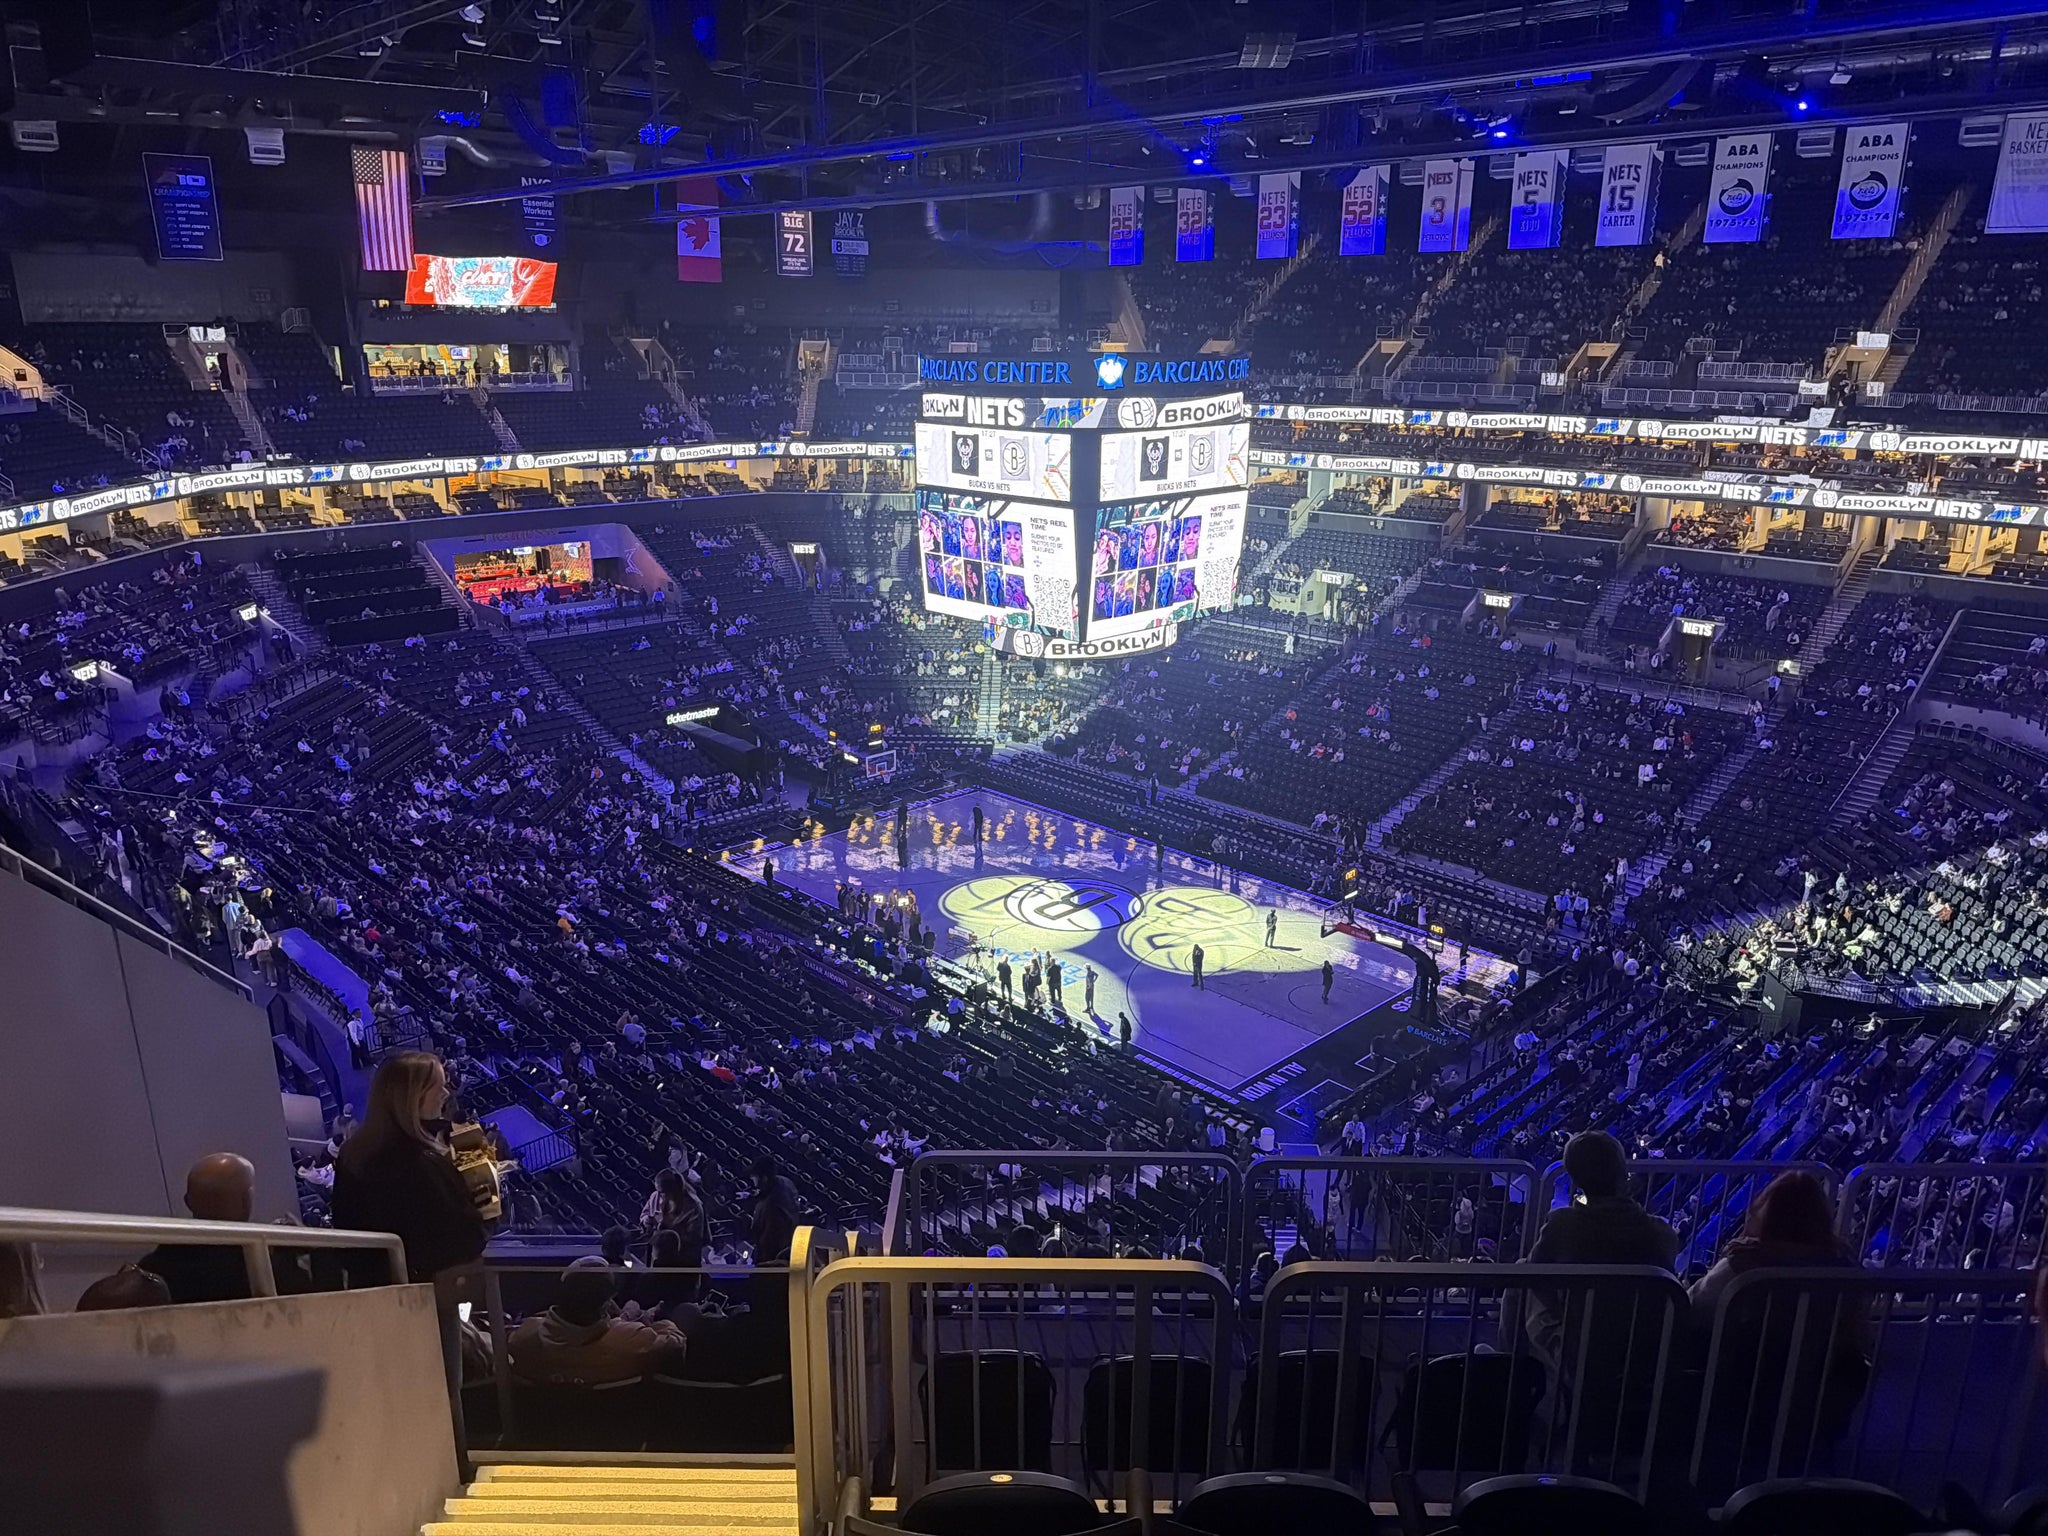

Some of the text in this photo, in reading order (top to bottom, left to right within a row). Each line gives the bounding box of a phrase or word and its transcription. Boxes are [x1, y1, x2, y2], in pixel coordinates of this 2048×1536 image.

[2026, 121, 2048, 139] NE
[1859, 134, 1894, 148] ABA
[1728, 144, 1760, 157] ABA
[1846, 152, 1899, 163] CHAMPIONS
[1715, 161, 1764, 171] CHAMPIONS
[1427, 172, 1453, 189] NETS
[1518, 170, 1548, 190] NETS
[1608, 164, 1642, 185] NETS
[1261, 191, 1286, 206] NETS
[1346, 185, 1373, 200] NETS
[1606, 184, 1636, 213] 15
[522, 198, 554, 209] Essential
[1112, 203, 1132, 217] NETS
[1179, 196, 1202, 211] NETS
[1523, 189, 1540, 216] 5
[523, 206, 552, 216] Workers
[1259, 206, 1286, 230] 23
[1344, 200, 1372, 226] 52
[1429, 197, 1446, 226] 3
[1838, 212, 1890, 224] 1973-74
[835, 212, 864, 229] JAY Z
[1111, 216, 1133, 239] 25
[1178, 211, 1203, 234] 32
[1602, 215, 1635, 227] CARTER
[1709, 217, 1757, 228] 1975-76
[783, 233, 805, 253] 72
[835, 240, 843, 252] 8
[921, 358, 1072, 385] BARCLAYS CENTER
[1134, 359, 1226, 384] BARCLAYS
[967, 396, 1026, 427] NETS
[1372, 408, 1404, 425] NETS
[1548, 415, 1587, 434] NETS
[1760, 426, 1807, 445] NETS
[599, 450, 627, 464] NETS
[732, 444, 756, 456] NETS
[868, 444, 895, 456] NETS
[444, 459, 478, 473] NETS
[1262, 453, 1286, 465] NETS
[1391, 459, 1420, 474] NETS
[266, 469, 304, 485] NETS
[1544, 470, 1578, 486] NETS
[968, 479, 1011, 492] BUCKS VS NETS
[1156, 480, 1197, 492] BUCKS VS NETS
[1722, 484, 1762, 501] NETS
[125, 486, 151, 504] NETS
[1934, 500, 1982, 519] NETS
[793, 545, 815, 554] NETS
[1322, 573, 1342, 584] NETS
[1485, 596, 1510, 608] NETS
[1683, 623, 1712, 636] NETS
[665, 707, 720, 725] ticketmaster
